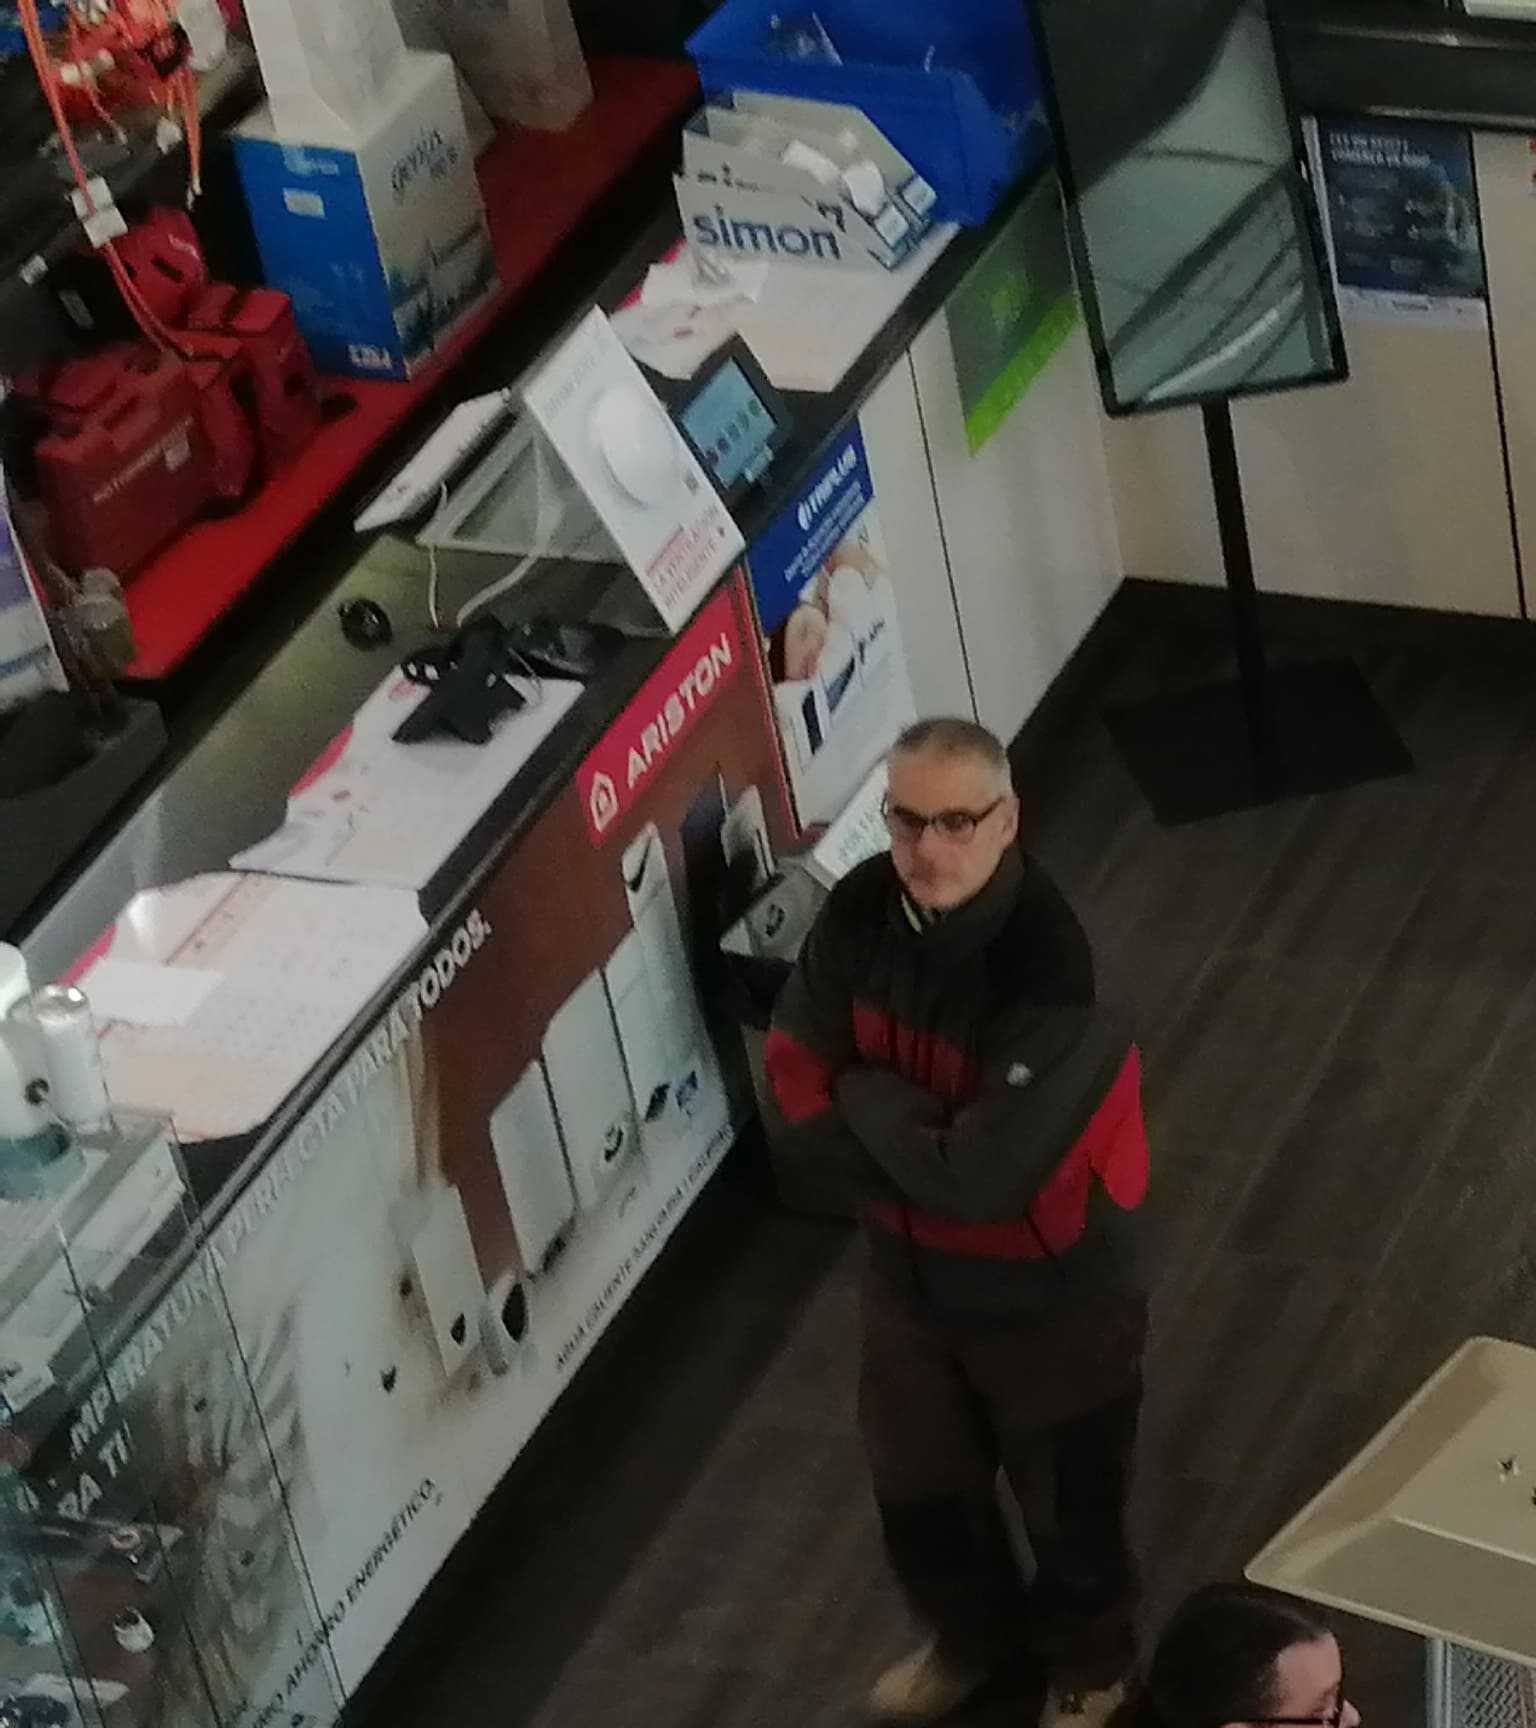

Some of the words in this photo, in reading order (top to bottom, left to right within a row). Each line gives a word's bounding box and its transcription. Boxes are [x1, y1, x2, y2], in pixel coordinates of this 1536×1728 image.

[693, 203, 841, 260] simon
[626, 632, 734, 791] ARISTON
[349, 1006, 411, 1106] PARA
